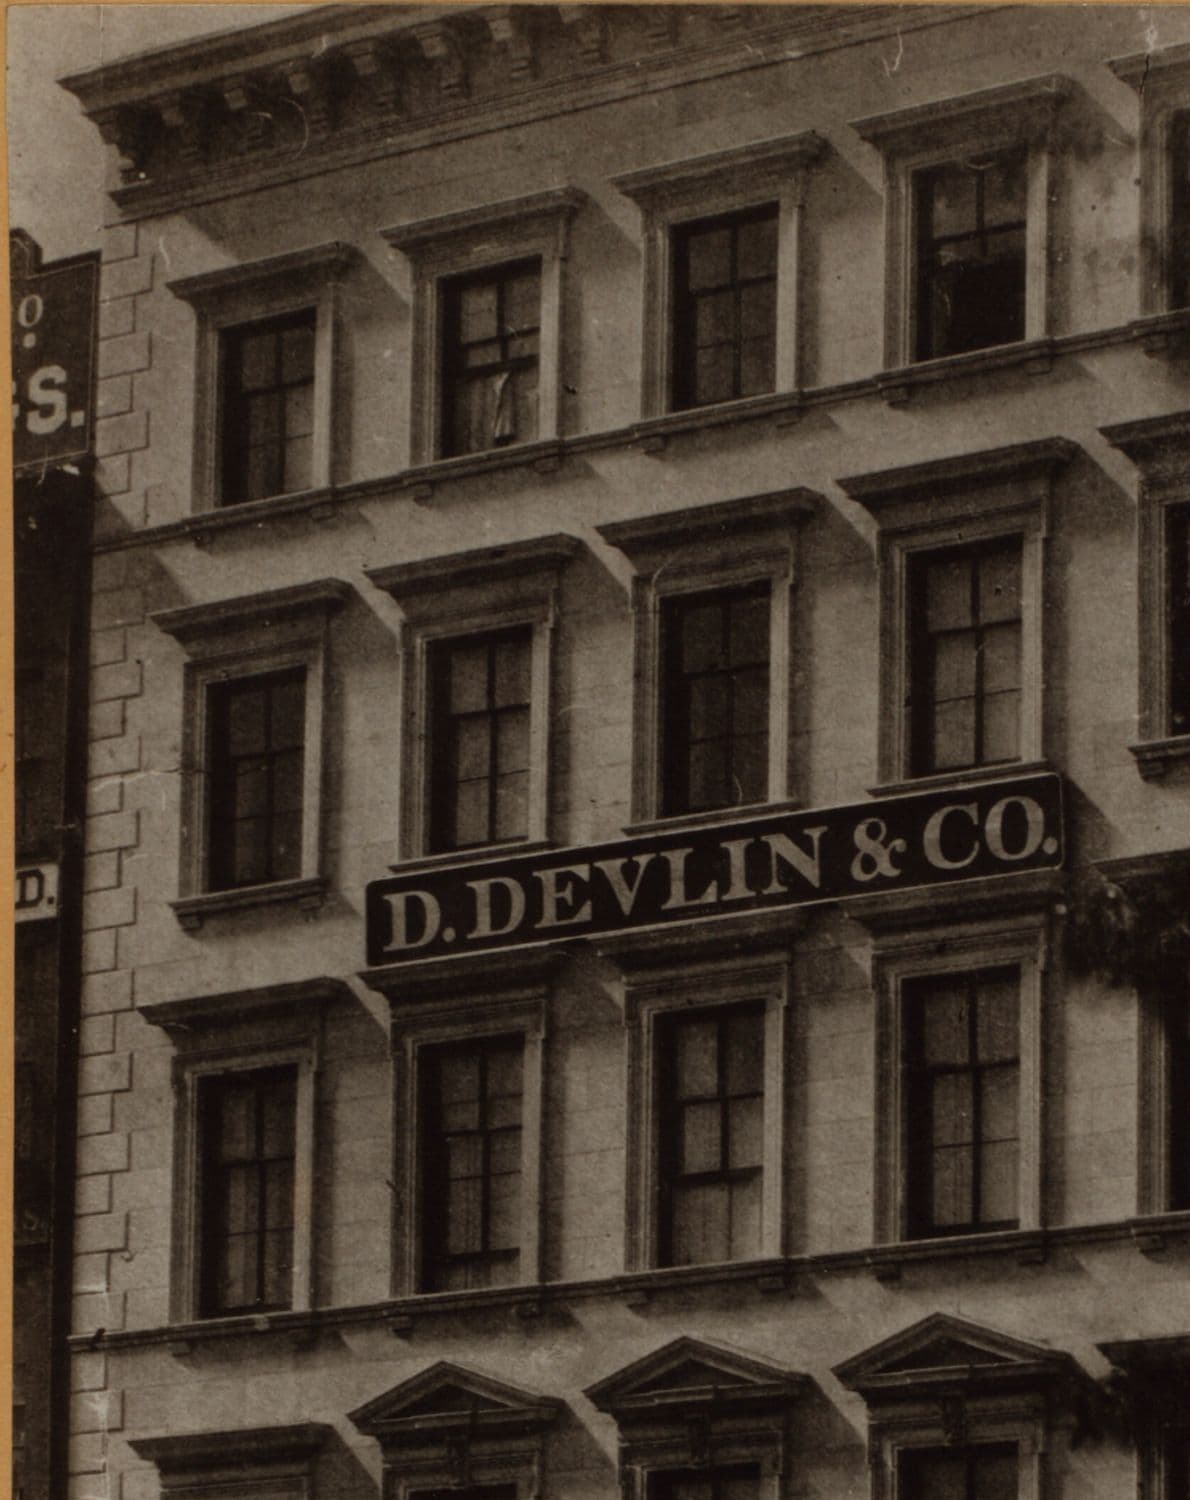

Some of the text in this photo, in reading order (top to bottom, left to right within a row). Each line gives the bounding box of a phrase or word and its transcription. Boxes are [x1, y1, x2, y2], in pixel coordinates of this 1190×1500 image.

[12, 364, 85, 435] S.
[466, 825, 829, 940] DEVLIN
[850, 816, 907, 882] &
[922, 794, 1060, 872] CO.
